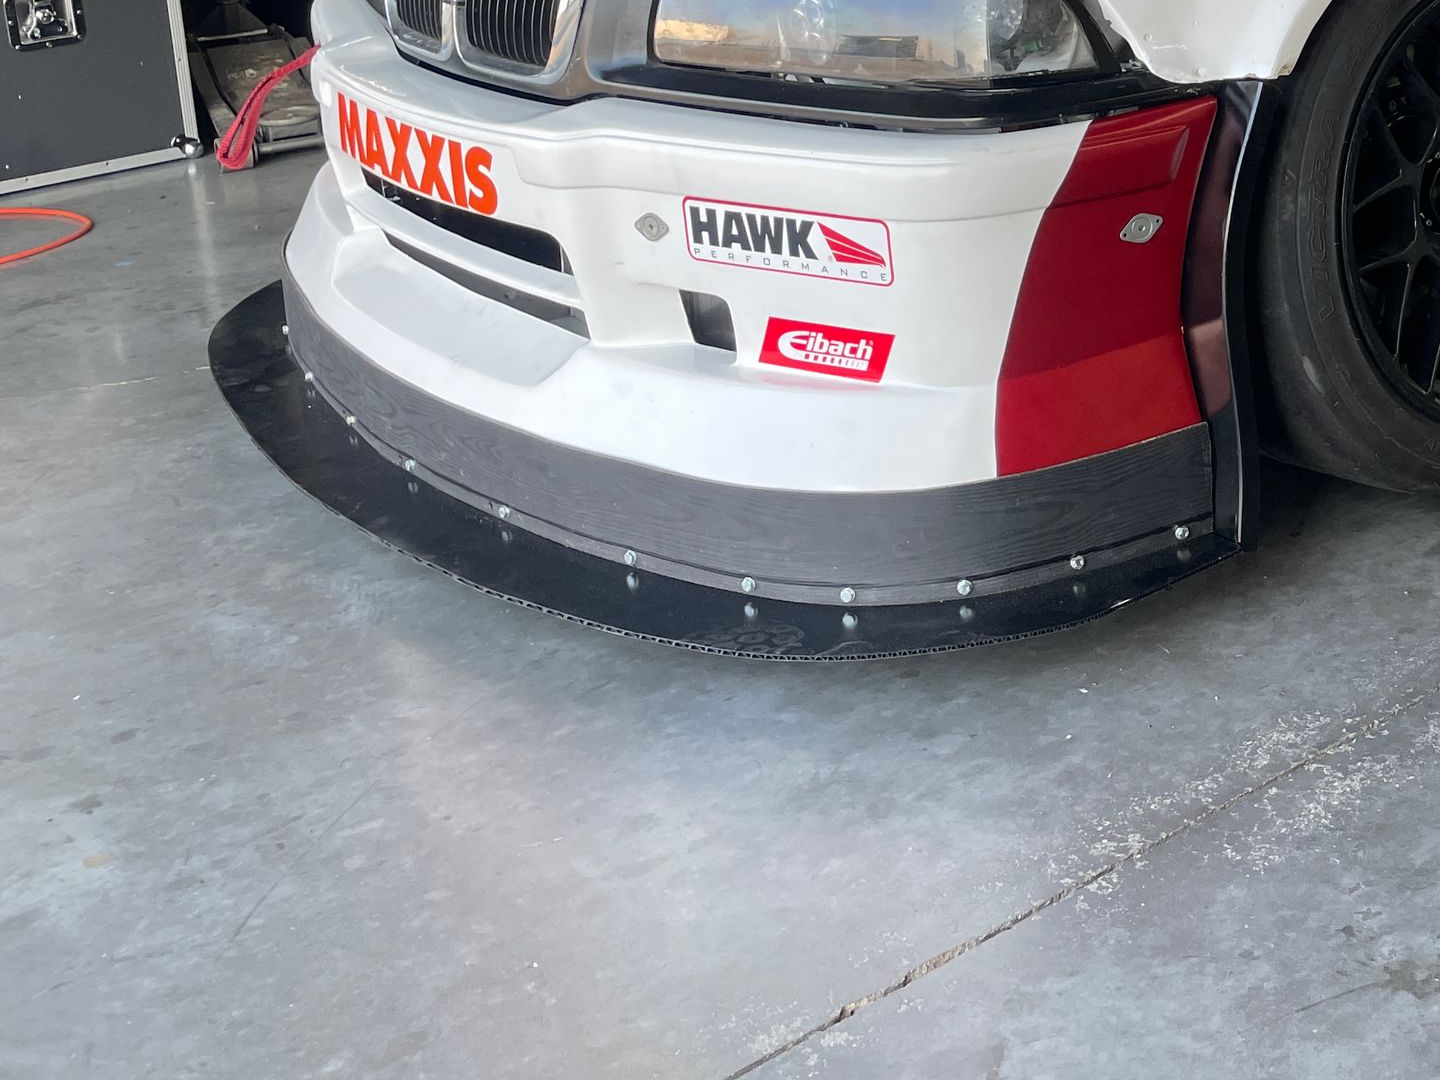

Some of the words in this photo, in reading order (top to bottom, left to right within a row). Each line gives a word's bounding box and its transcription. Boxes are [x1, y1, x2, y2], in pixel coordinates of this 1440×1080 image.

[337, 91, 498, 216] MAXXIS
[688, 205, 819, 261] HAWK
[694, 247, 888, 282] PERFORMANCE
[777, 330, 874, 370] Eibach
